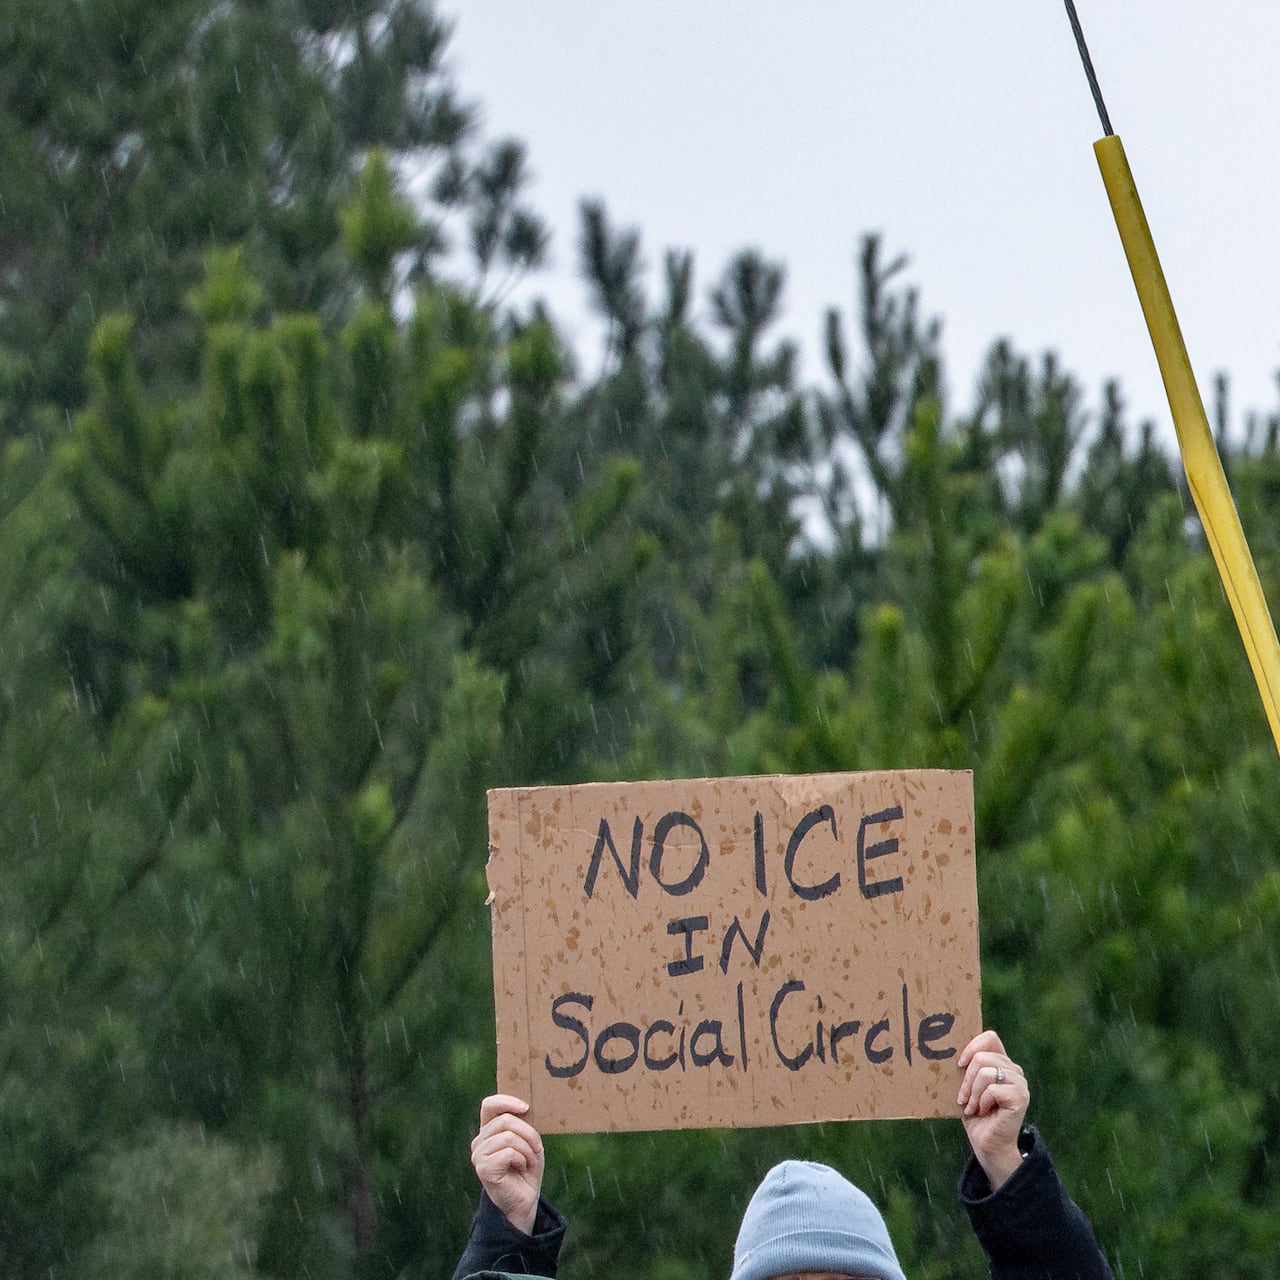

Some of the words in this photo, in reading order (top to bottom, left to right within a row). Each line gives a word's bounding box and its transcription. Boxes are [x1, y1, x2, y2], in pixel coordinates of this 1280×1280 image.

[584, 811, 710, 899] NO
[754, 805, 904, 901] ICE
[667, 909, 770, 976] IN
[545, 981, 748, 1078] Social
[769, 980, 957, 1071] Circle
